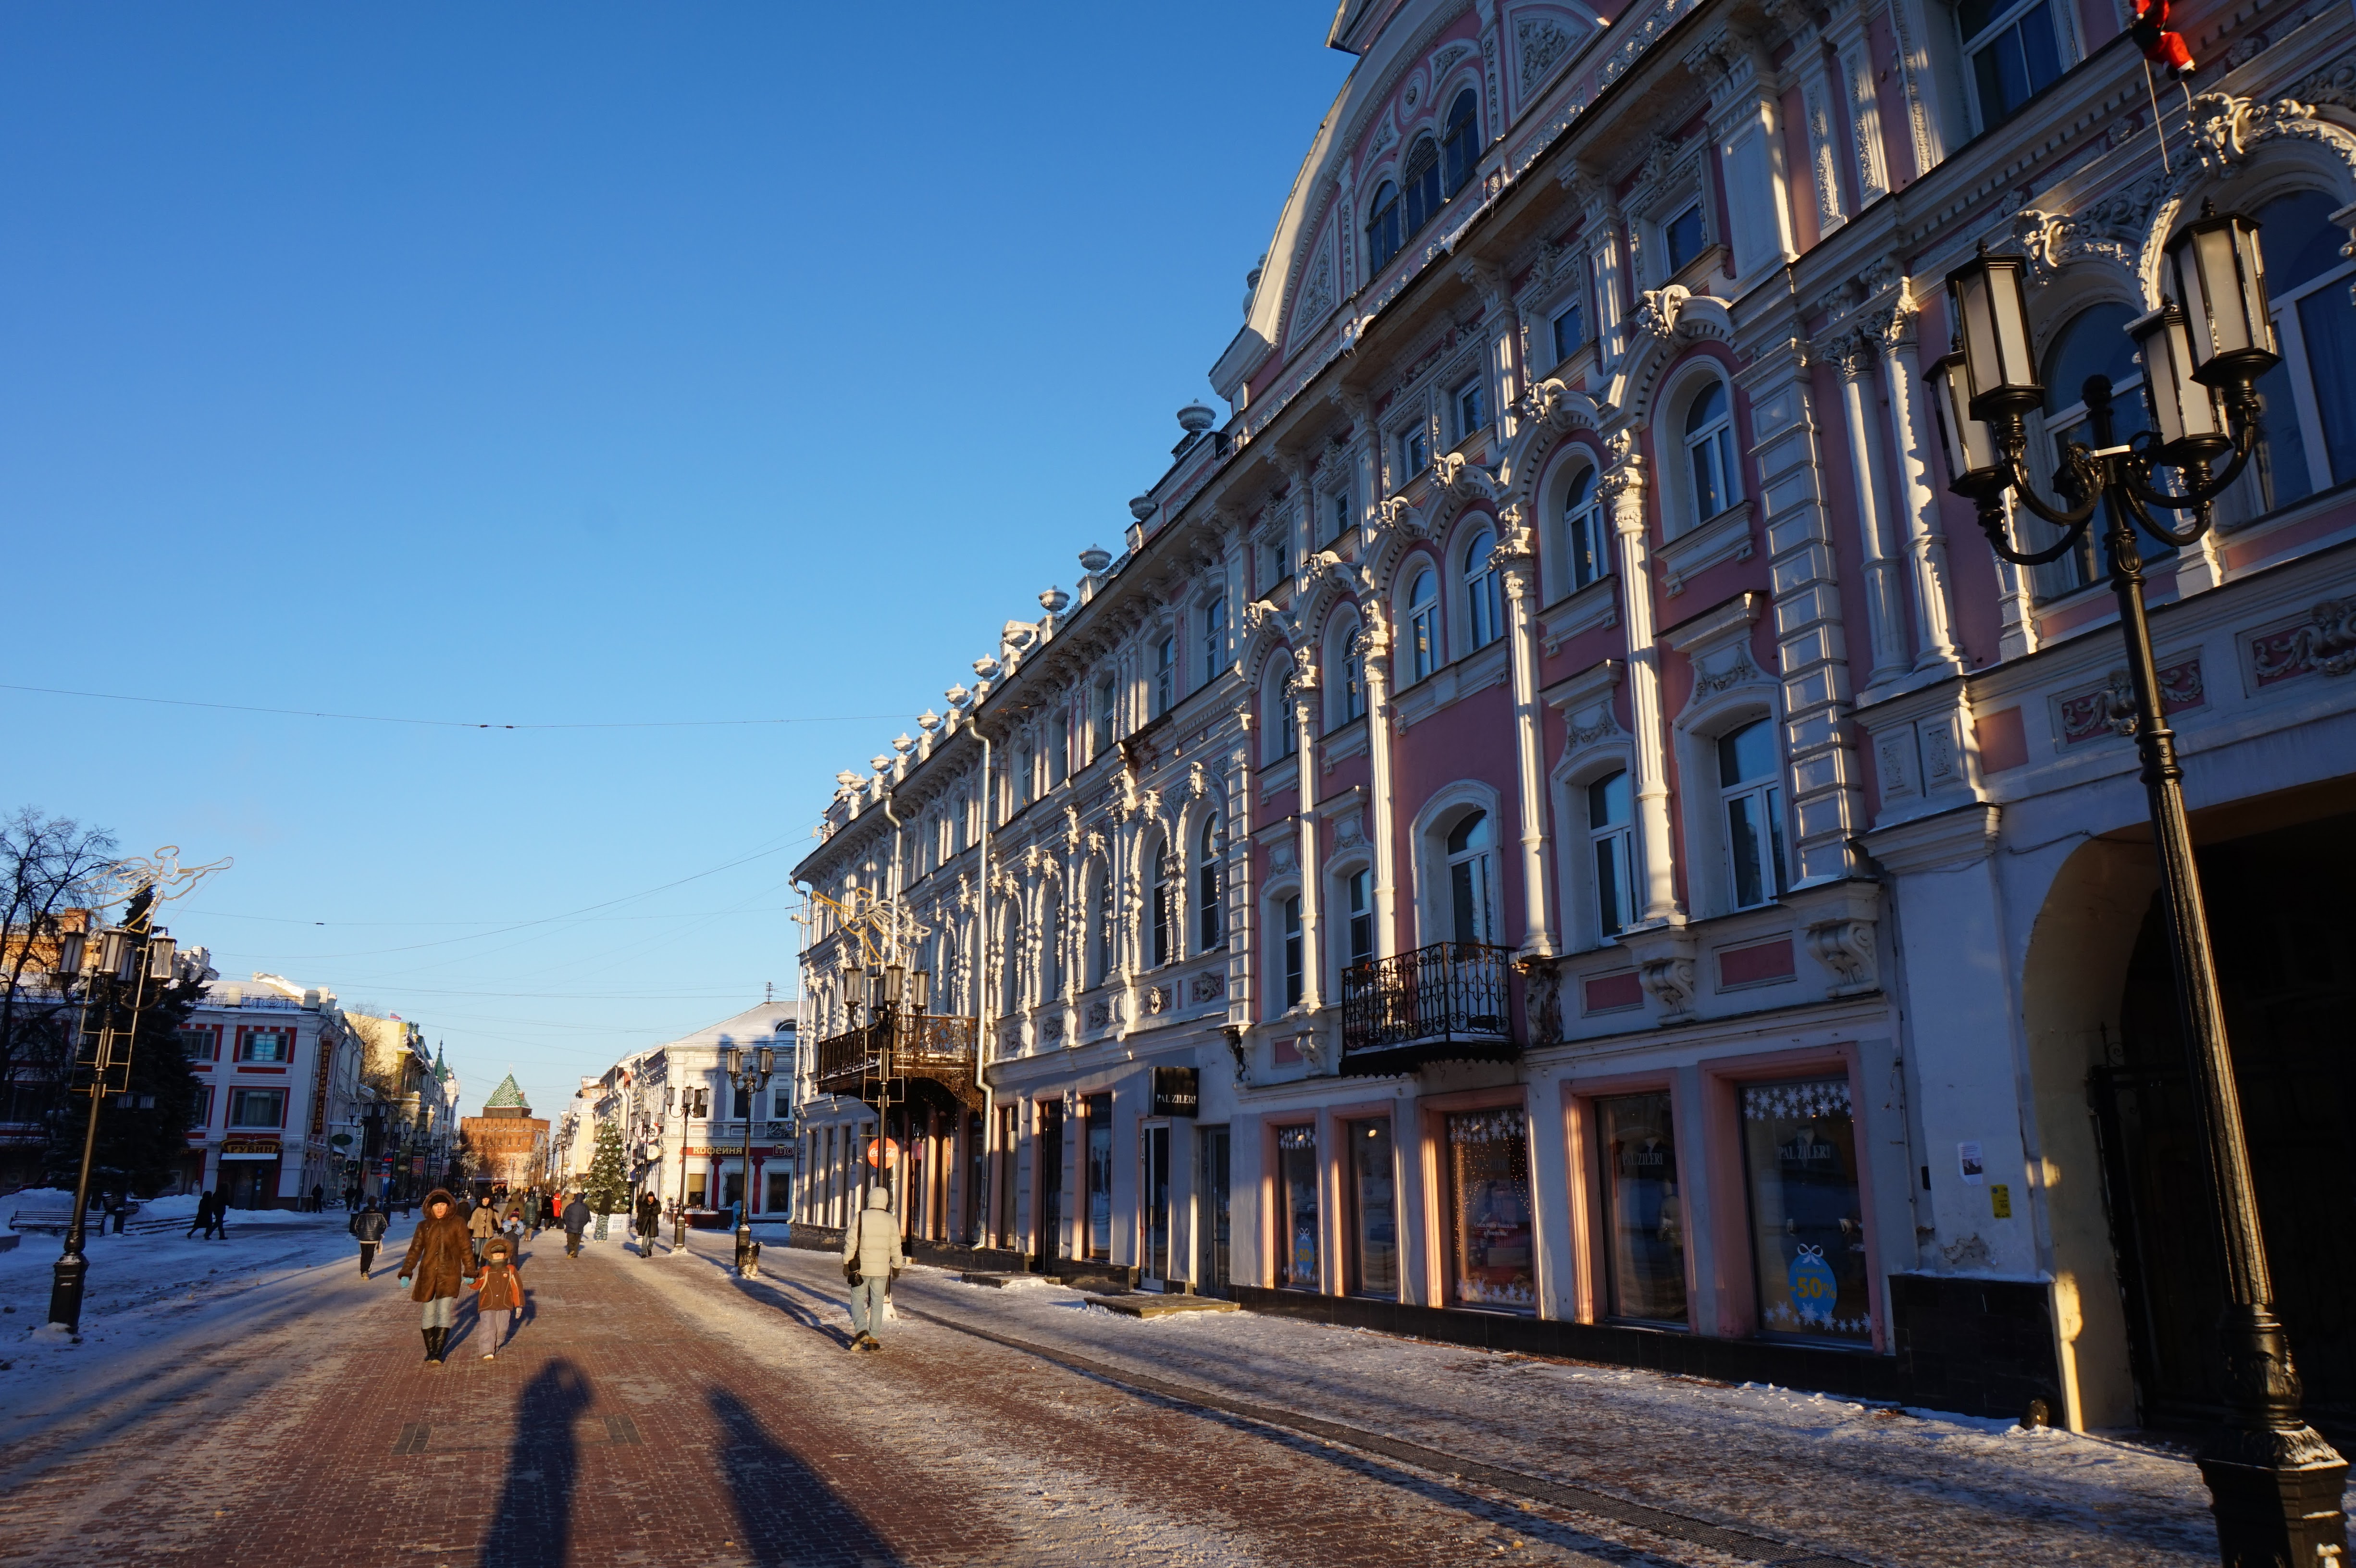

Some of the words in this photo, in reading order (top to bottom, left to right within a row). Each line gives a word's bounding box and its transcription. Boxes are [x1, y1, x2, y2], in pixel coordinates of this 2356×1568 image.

[1157, 1094, 1170, 1103] PAL
[1172, 1094, 1196, 1104] ZILERI
[315, 1101, 323, 1129] САЛОН
[693, 1145, 742, 1156] кофейня
[1778, 1146, 1796, 1159] PAL
[1797, 1145, 1831, 1159] ZILERI
[1622, 1153, 1636, 1165] PAL
[1638, 1153, 1663, 1165] ZILERI
[1789, 1277, 1837, 1299] -50%
